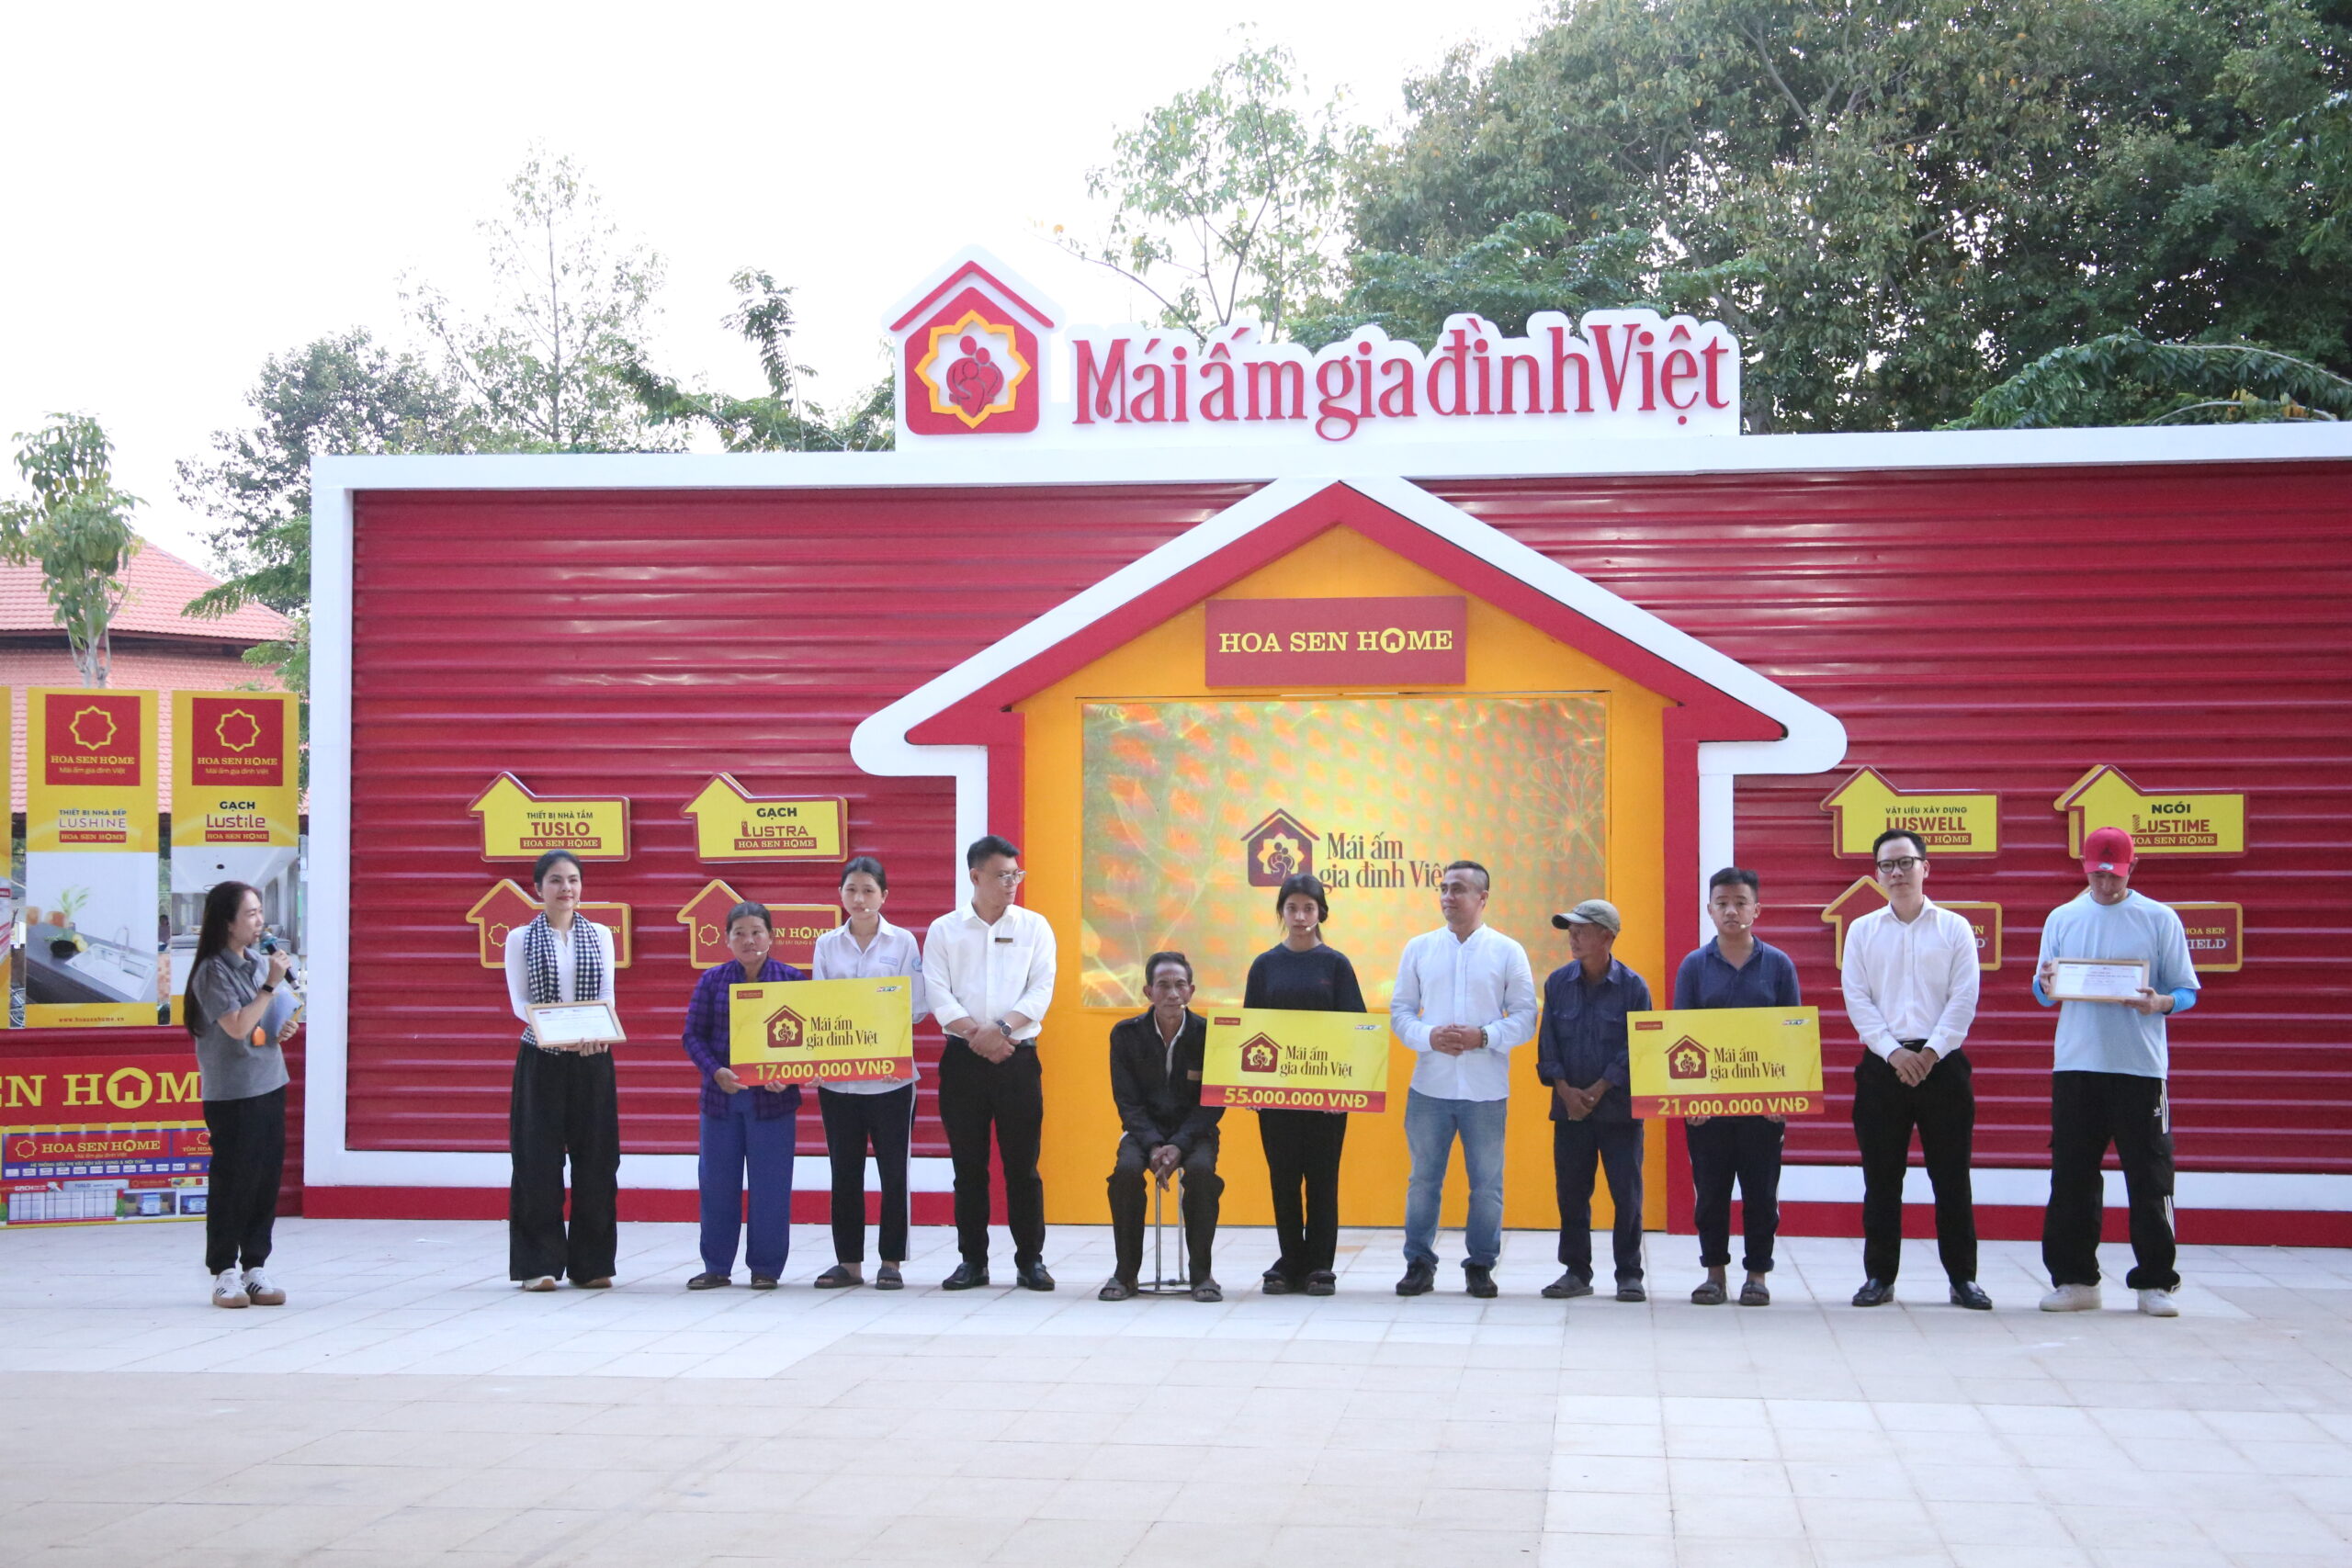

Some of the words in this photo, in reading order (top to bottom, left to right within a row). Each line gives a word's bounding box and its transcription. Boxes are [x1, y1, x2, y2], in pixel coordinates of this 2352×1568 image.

[1071, 338, 1190, 424] Mái
[1199, 327, 1308, 422] ấm
[1315, 341, 1418, 442] gia
[1426, 318, 1595, 416] đình
[1588, 323, 1730, 425] Việt
[1218, 632, 1283, 653] HOA
[1289, 631, 1349, 652] SEN
[1356, 627, 1453, 654] HOME
[51, 755, 74, 764] HOA
[75, 755, 98, 764] SEN
[99, 755, 135, 765] HOME
[197, 757, 220, 765] HOA
[220, 757, 243, 765] SEN
[243, 756, 278, 766] HOME
[220, 800, 255, 812] GẠCH
[756, 807, 797, 820] GẠCH
[1885, 807, 1902, 816] VẬT
[1904, 806, 1920, 816] LIỆU
[1923, 806, 1940, 814] XÂY
[1942, 807, 1968, 815] DỰNG
[2151, 801, 2191, 814] NGÓI
[206, 814, 266, 829] Lustile
[526, 809, 546, 819] THIẾT
[548, 812, 556, 820] BỊ
[558, 810, 575, 819] NHÀ
[59, 818, 127, 829] LUSHINE
[530, 821, 591, 837] TUSLO
[741, 820, 809, 837] LUSTRA
[1886, 817, 1966, 831] LUSWELL
[2132, 814, 2211, 833] LUSTIME
[567, 839, 598, 848] HOME
[761, 840, 781, 848] SEN
[783, 839, 815, 848] HOME
[1327, 831, 1364, 860] Mái
[1370, 830, 1404, 860] ấm
[1934, 834, 1969, 844] HOME
[2154, 836, 2177, 844] SEN
[2178, 835, 2215, 845] HOME
[1319, 863, 1350, 894] gia
[1355, 861, 1405, 888] đình
[2188, 938, 2227, 950] IELD
[810, 1016, 831, 1032] Mái
[834, 1014, 853, 1031] ấm
[806, 1033, 823, 1051] gia
[855, 1029, 878, 1047] Việt
[1285, 1045, 1307, 1060] Mái
[1309, 1045, 1329, 1061] ấm
[1713, 1047, 1736, 1063] Mái
[1739, 1046, 1758, 1062] ấm
[755, 1062, 852, 1081] 17.000.000
[854, 1059, 896, 1076] VNĐ
[1280, 1061, 1297, 1077] gia
[1330, 1061, 1352, 1079] Việt
[1710, 1065, 1728, 1083] gia
[1761, 1062, 1786, 1079] Việt
[62, 1066, 202, 1109] HOM
[1223, 1088, 1324, 1107] 55.000.000
[1327, 1093, 1368, 1109] VNĐ
[1657, 1098, 1764, 1116] 21.000.000
[1767, 1097, 1809, 1113] VNĐ
[41, 1143, 75, 1154] HOA
[77, 1142, 108, 1152] SEN
[111, 1139, 161, 1152] HOME
